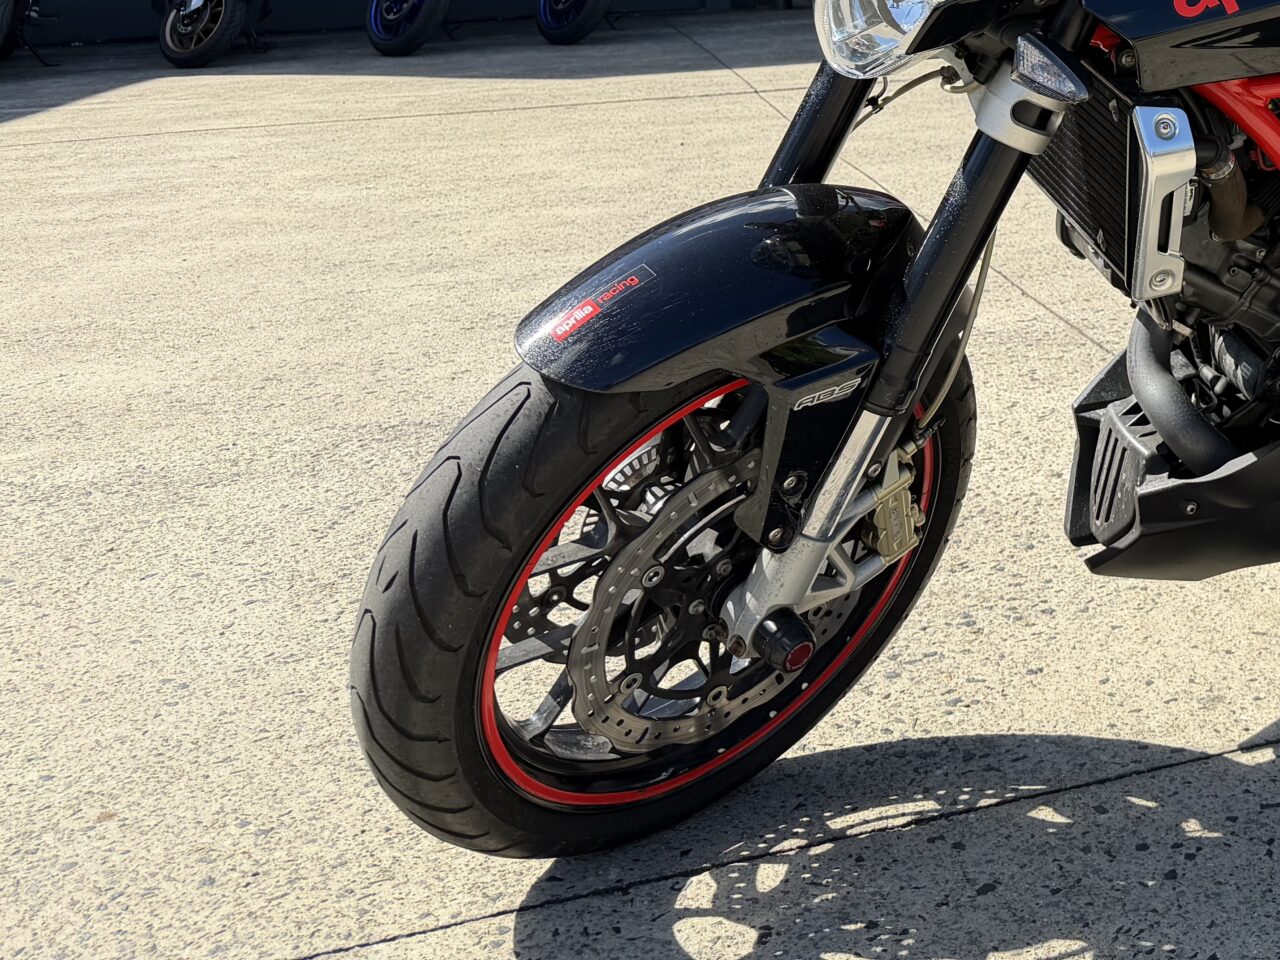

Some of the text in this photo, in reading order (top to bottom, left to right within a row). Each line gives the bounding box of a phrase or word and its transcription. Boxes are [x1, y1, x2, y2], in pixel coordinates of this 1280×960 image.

[554, 275, 639, 335] aprilia racing
[793, 377, 862, 411] ABS
